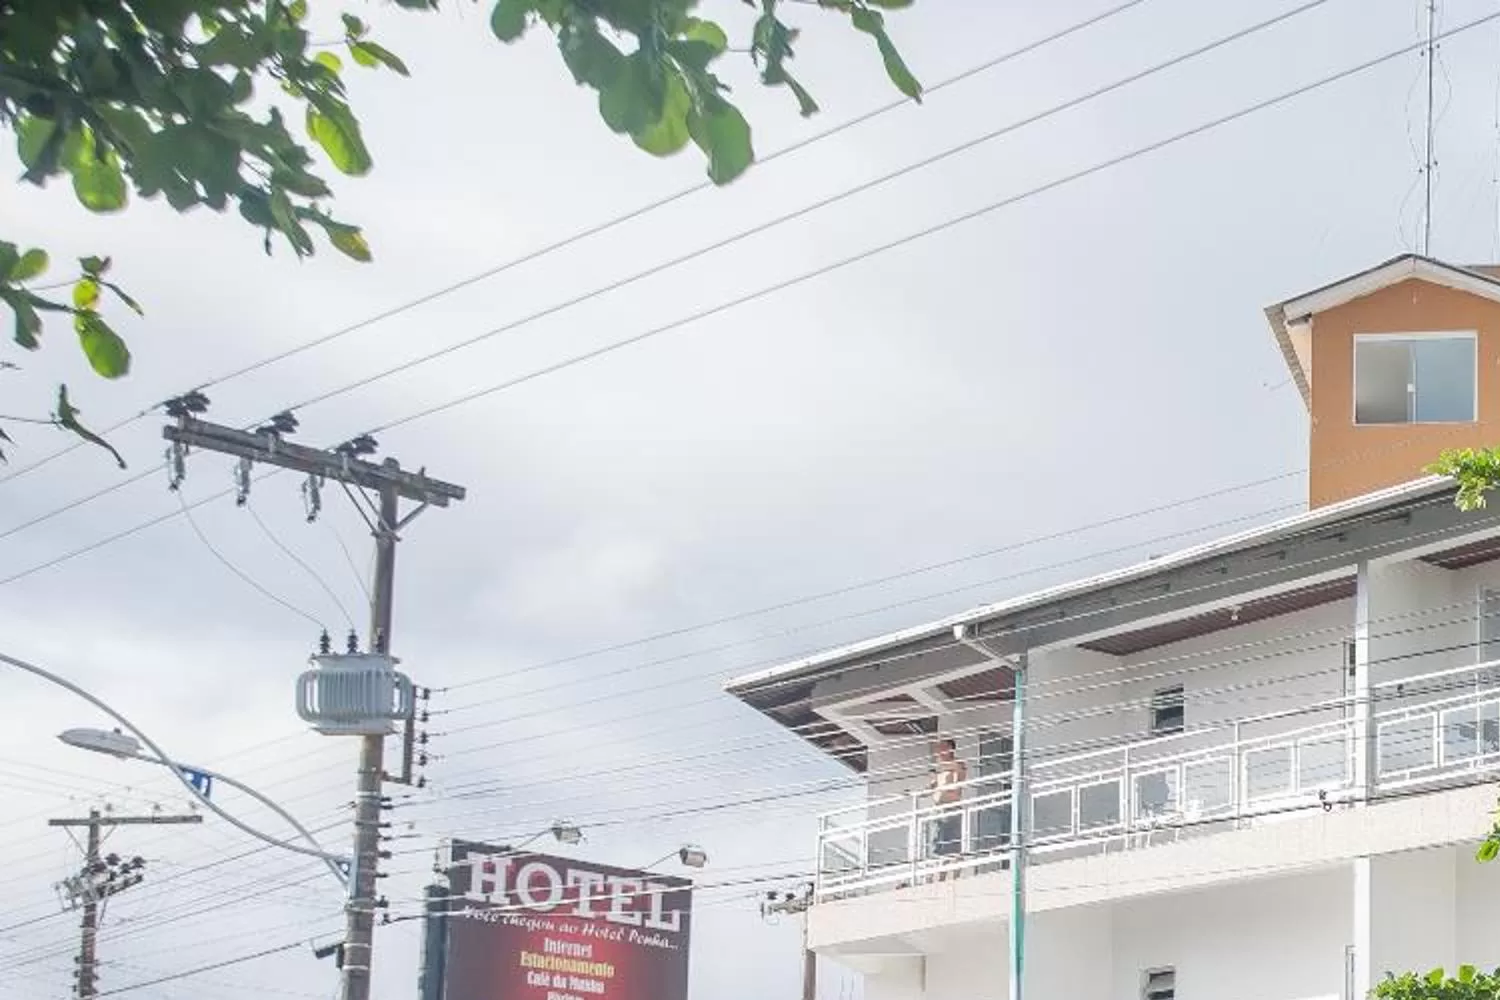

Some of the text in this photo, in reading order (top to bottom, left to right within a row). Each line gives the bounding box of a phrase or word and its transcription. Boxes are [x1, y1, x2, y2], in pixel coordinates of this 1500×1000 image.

[464, 851, 681, 932] HOTEL
[581, 922, 624, 941] Hotel
[543, 937, 592, 958] Internet
[520, 950, 615, 978] Estacionamento
